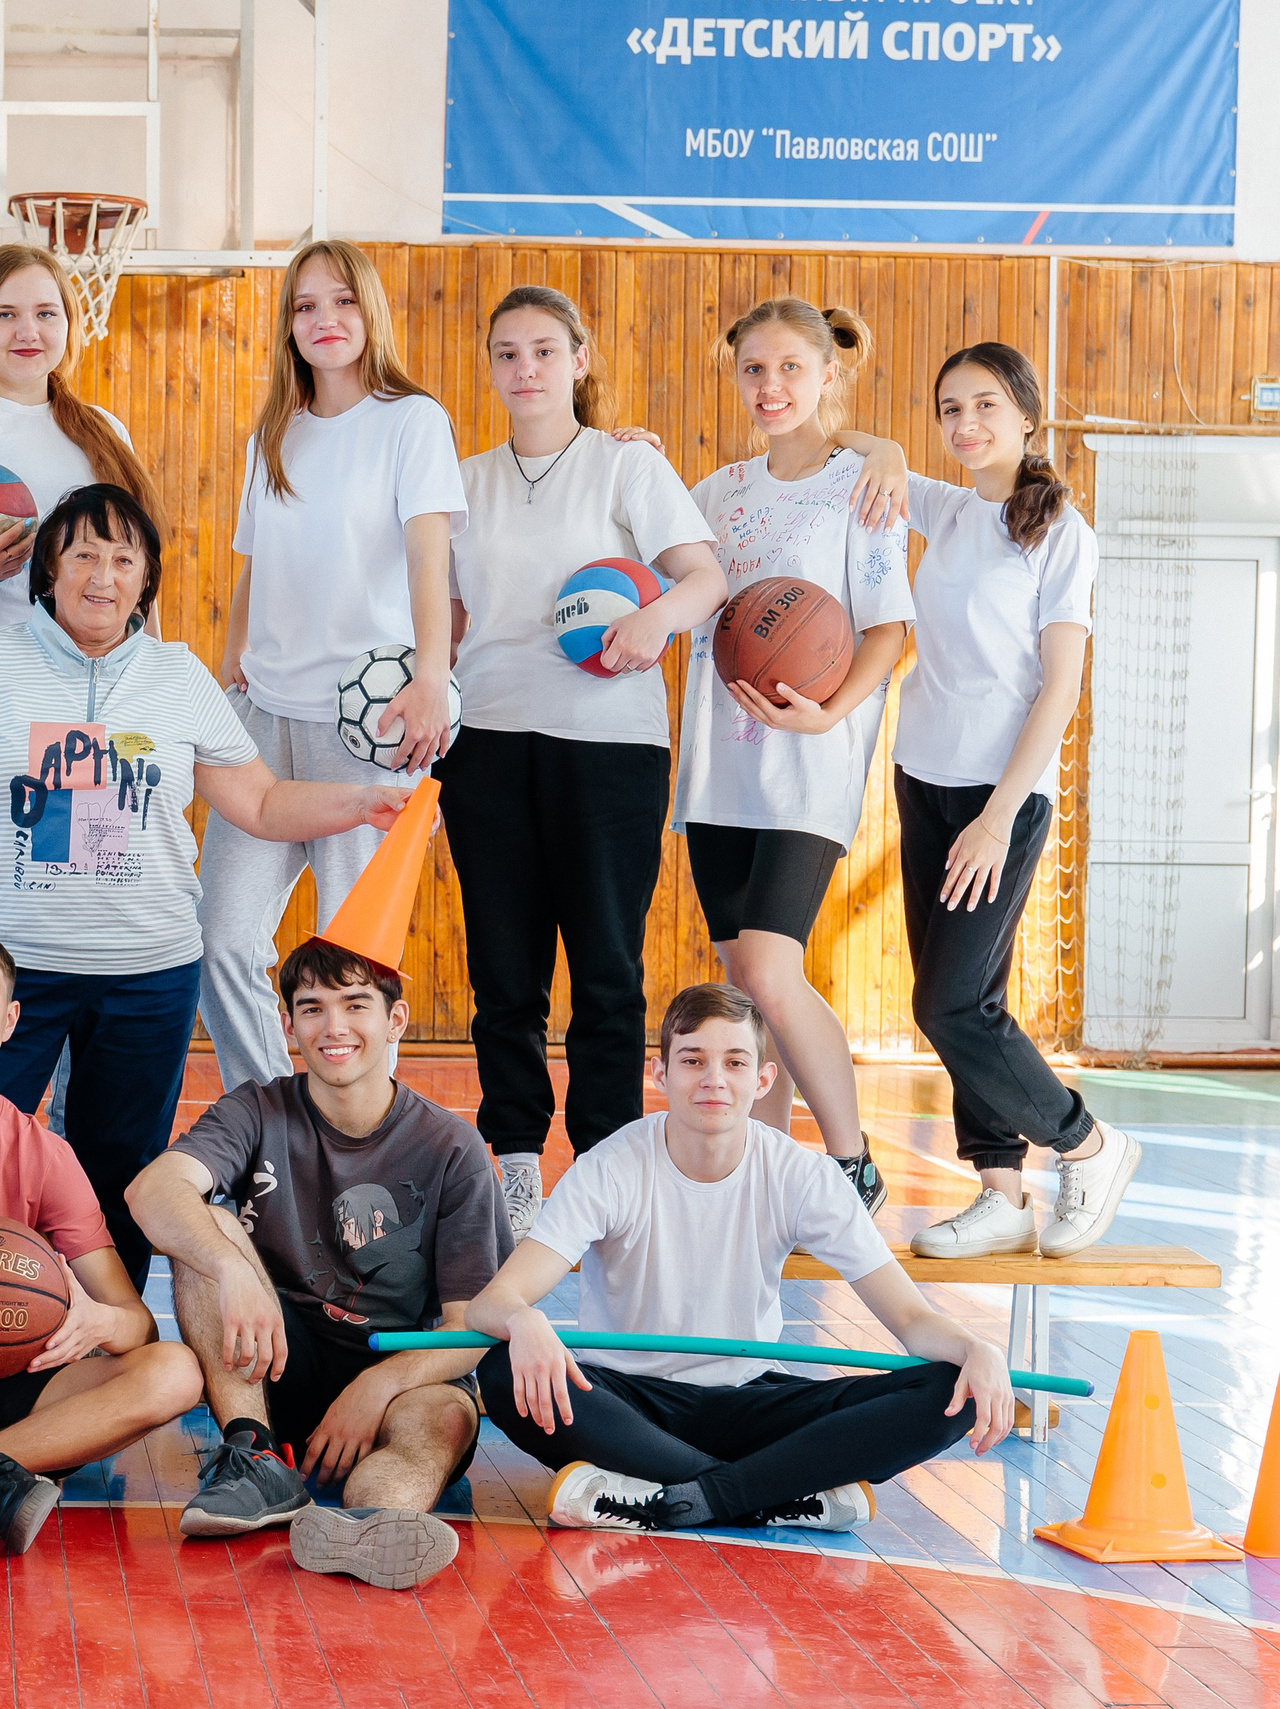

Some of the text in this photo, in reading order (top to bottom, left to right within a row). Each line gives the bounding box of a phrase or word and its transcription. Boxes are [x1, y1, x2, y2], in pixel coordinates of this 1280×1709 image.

[626, 10, 1063, 65] «ДЕТСКИЙ СПОРТ»
[685, 127, 755, 158] МБОУ
[753, 608, 782, 640] BM
[775, 586, 806, 611] 300
